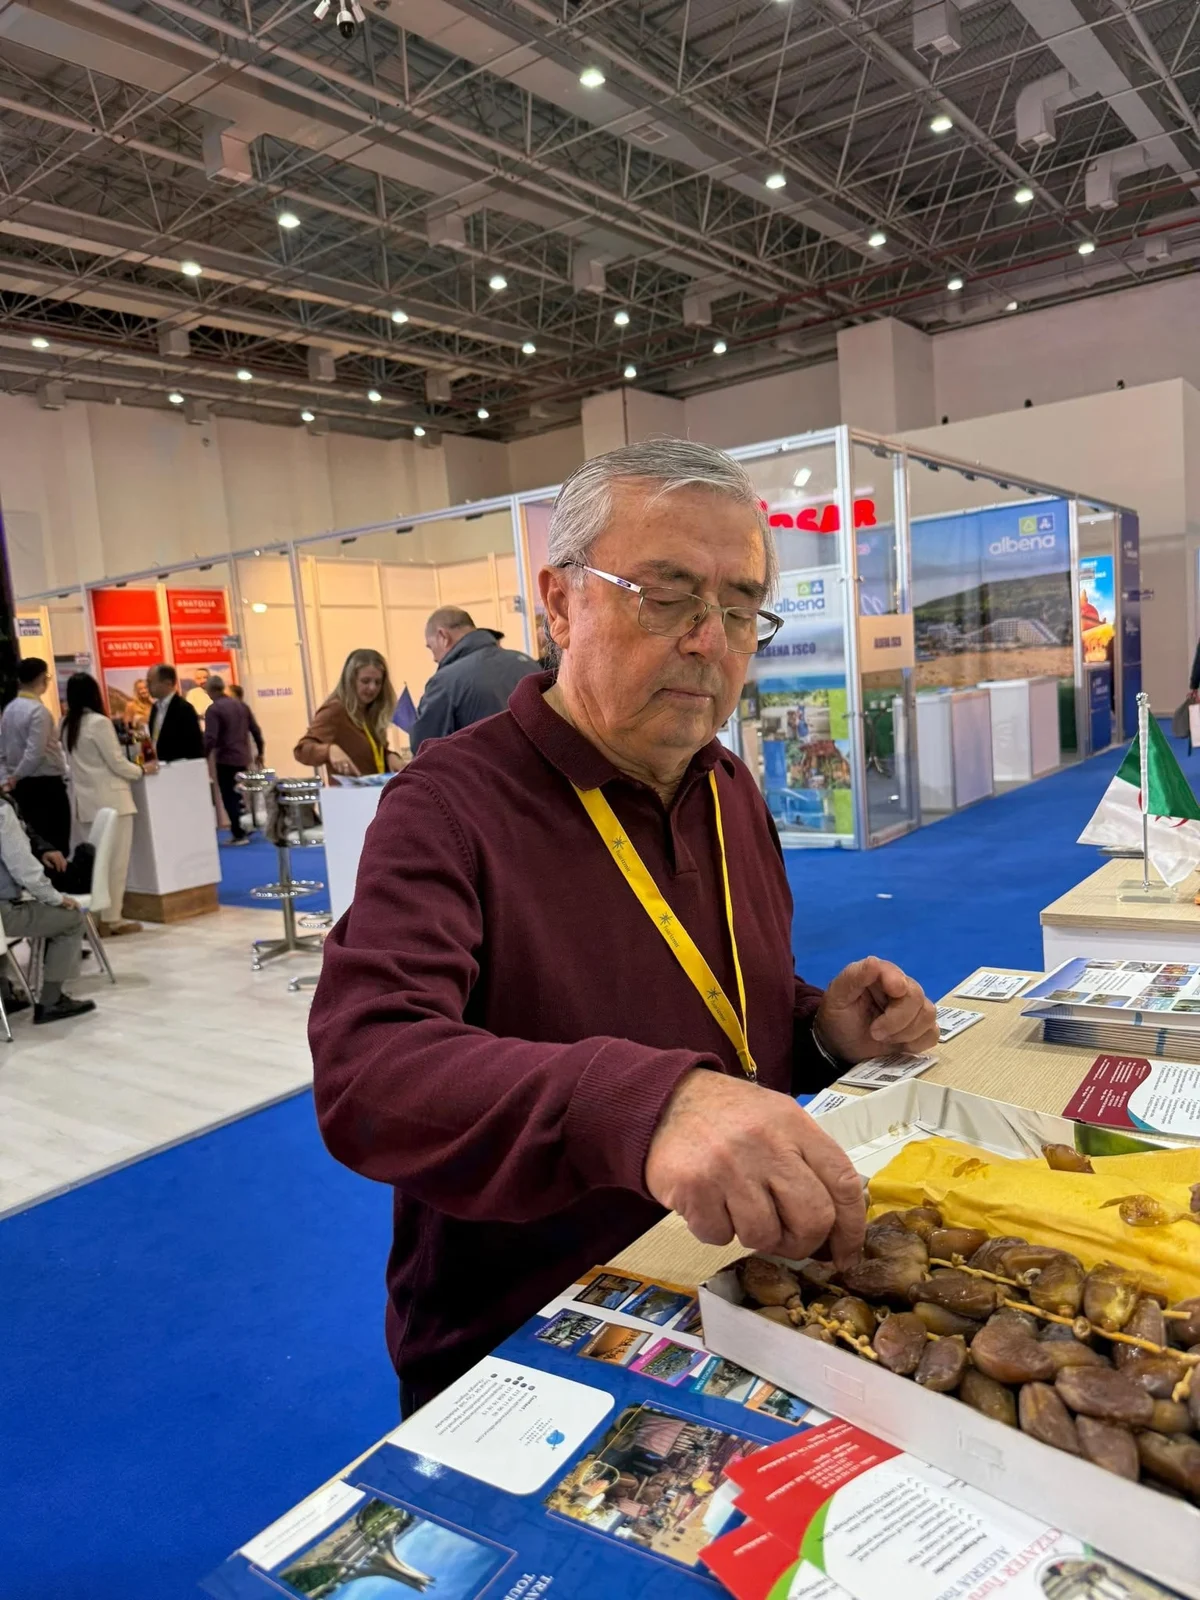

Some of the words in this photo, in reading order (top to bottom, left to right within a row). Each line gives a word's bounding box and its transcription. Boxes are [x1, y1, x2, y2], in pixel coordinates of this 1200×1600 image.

[989, 535, 1056, 555] albena
[177, 600, 216, 608] ANATOLIA
[774, 598, 825, 613] albena
[107, 642, 154, 651] ANATOLIA
[180, 639, 222, 648] ANATOLIA
[956, 1544, 1011, 1586] ALGERIA
